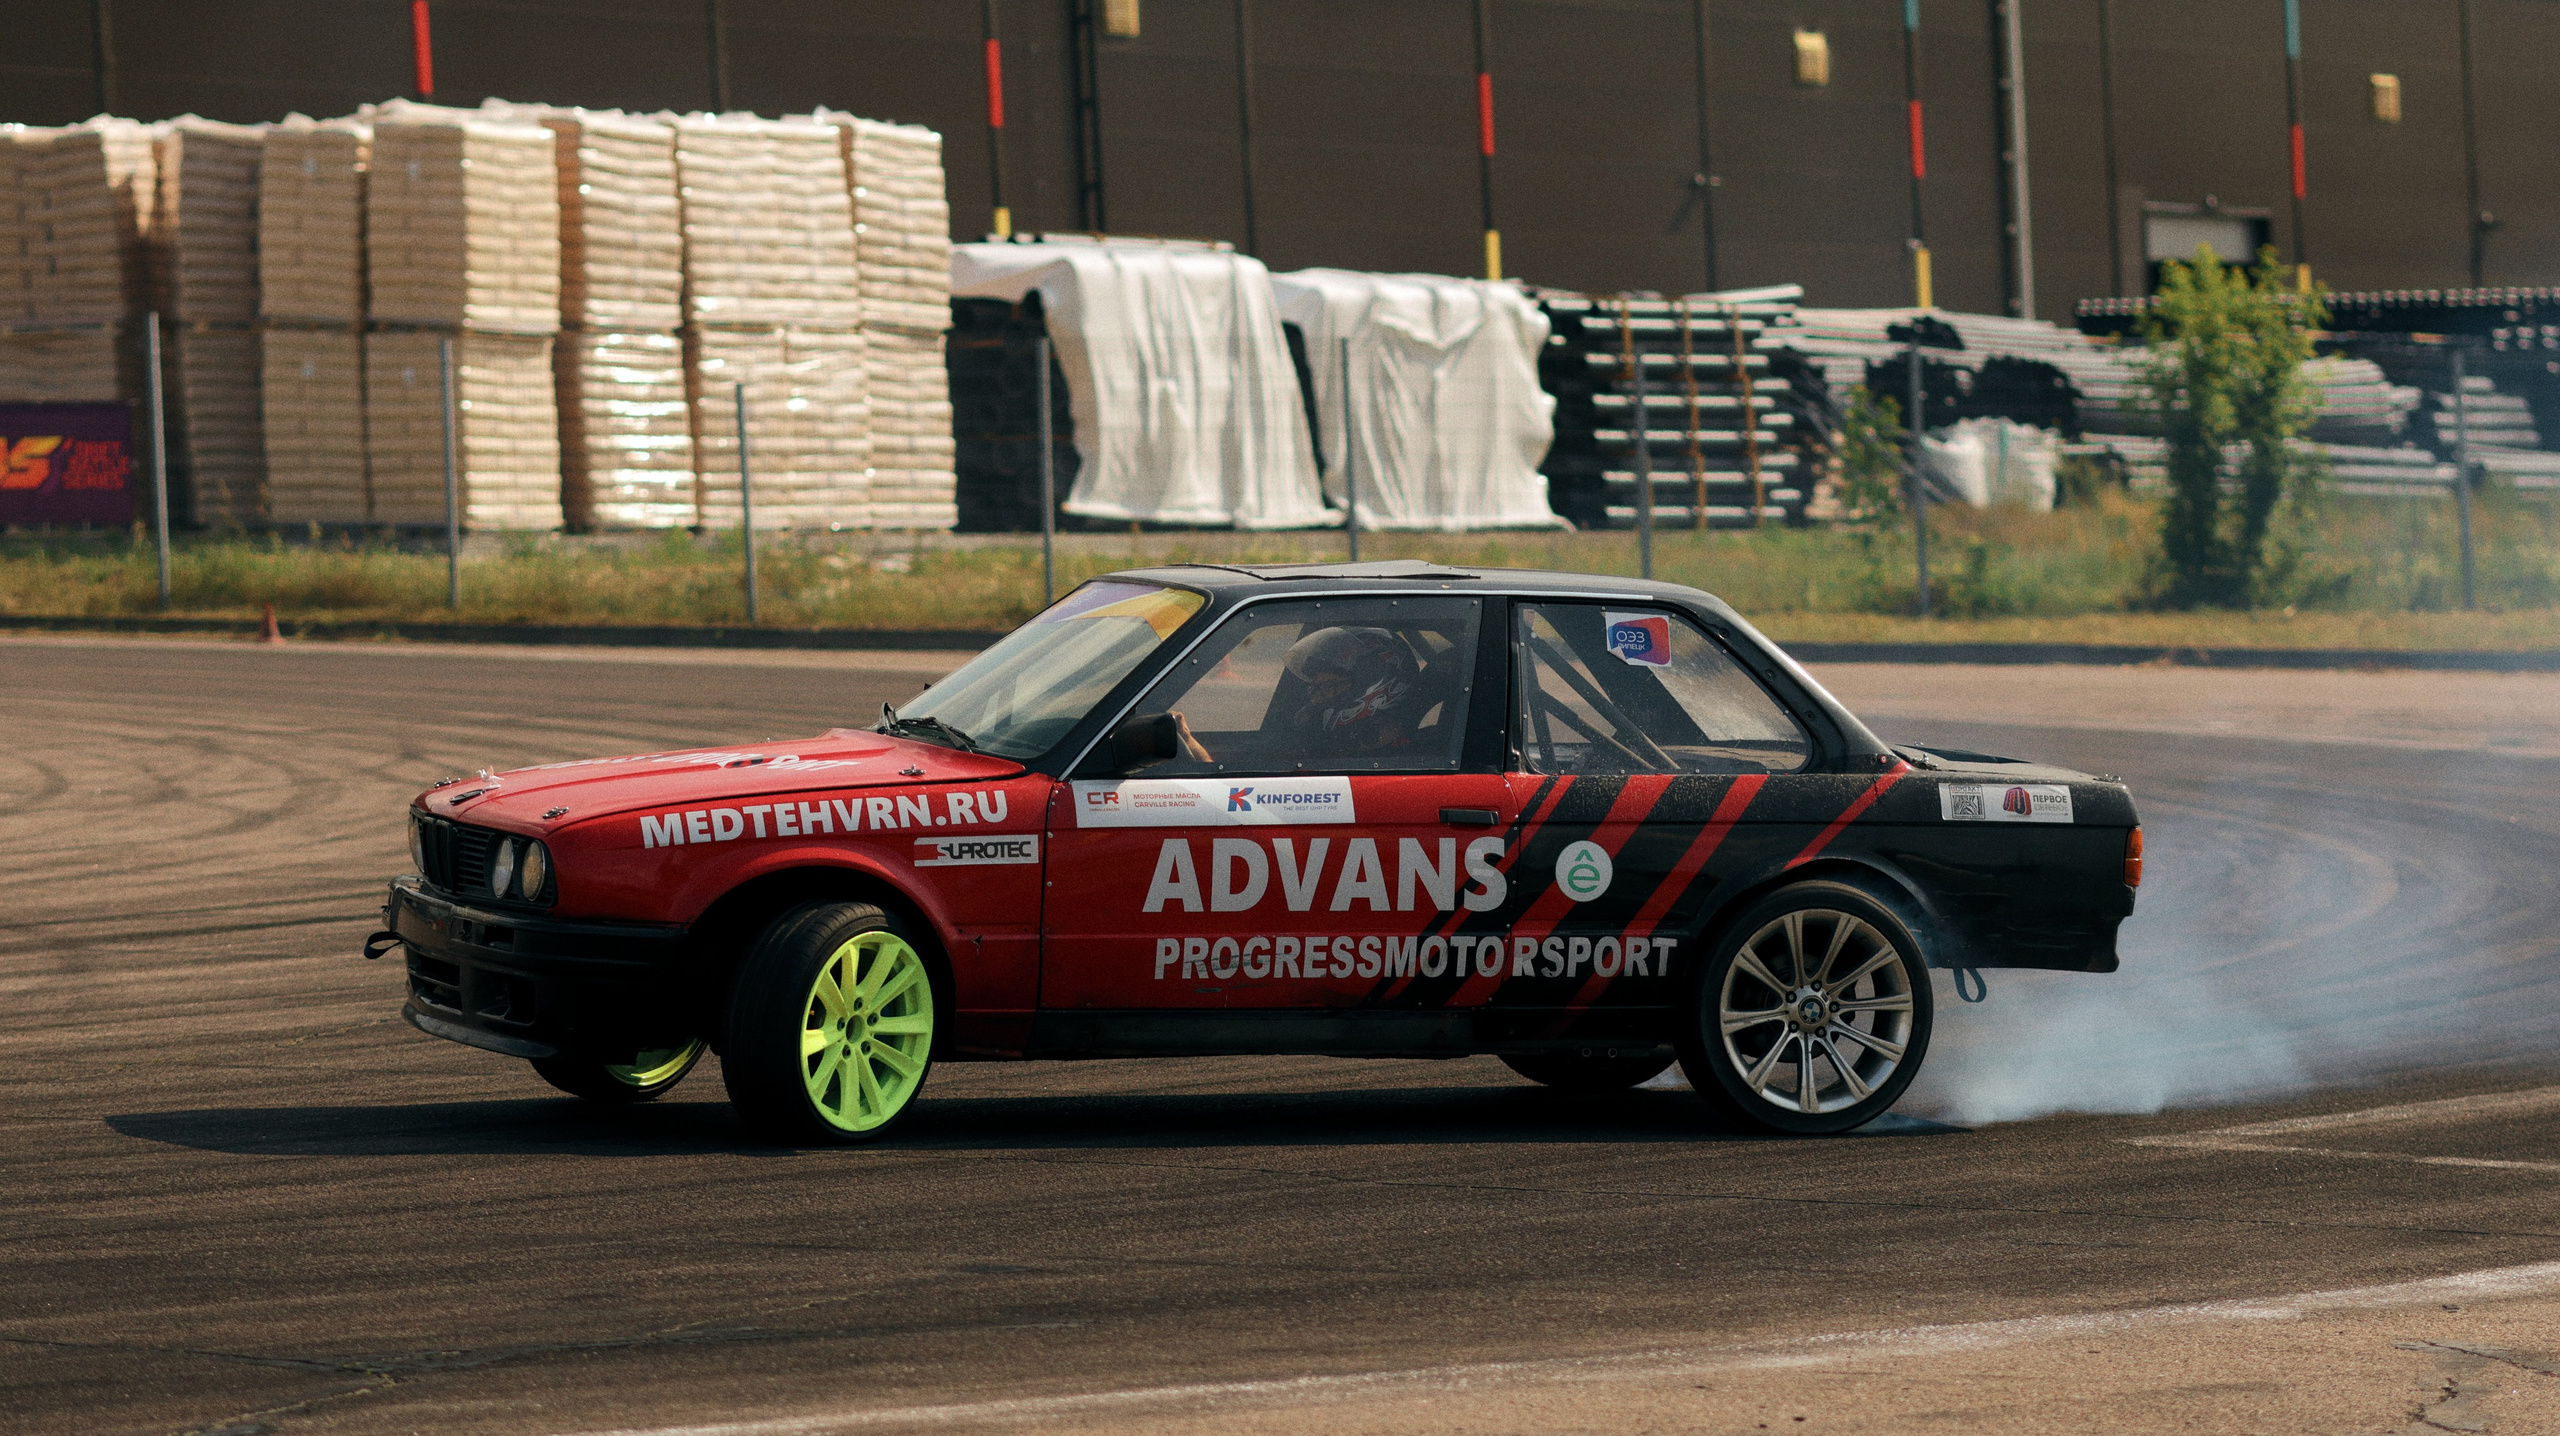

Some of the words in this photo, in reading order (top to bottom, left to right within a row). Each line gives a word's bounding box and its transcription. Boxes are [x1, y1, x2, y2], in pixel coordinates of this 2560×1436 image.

[1087, 791, 1119, 805] CR
[1175, 792, 1202, 800] МАСЛА
[1256, 793, 1341, 804] KINFOREST
[2032, 794, 2068, 804] ПЕРВОЕ
[639, 790, 1009, 849] MEDTEHVRN.RU
[935, 840, 1032, 862] SUPROTEC
[1142, 836, 1508, 913] ADVANS
